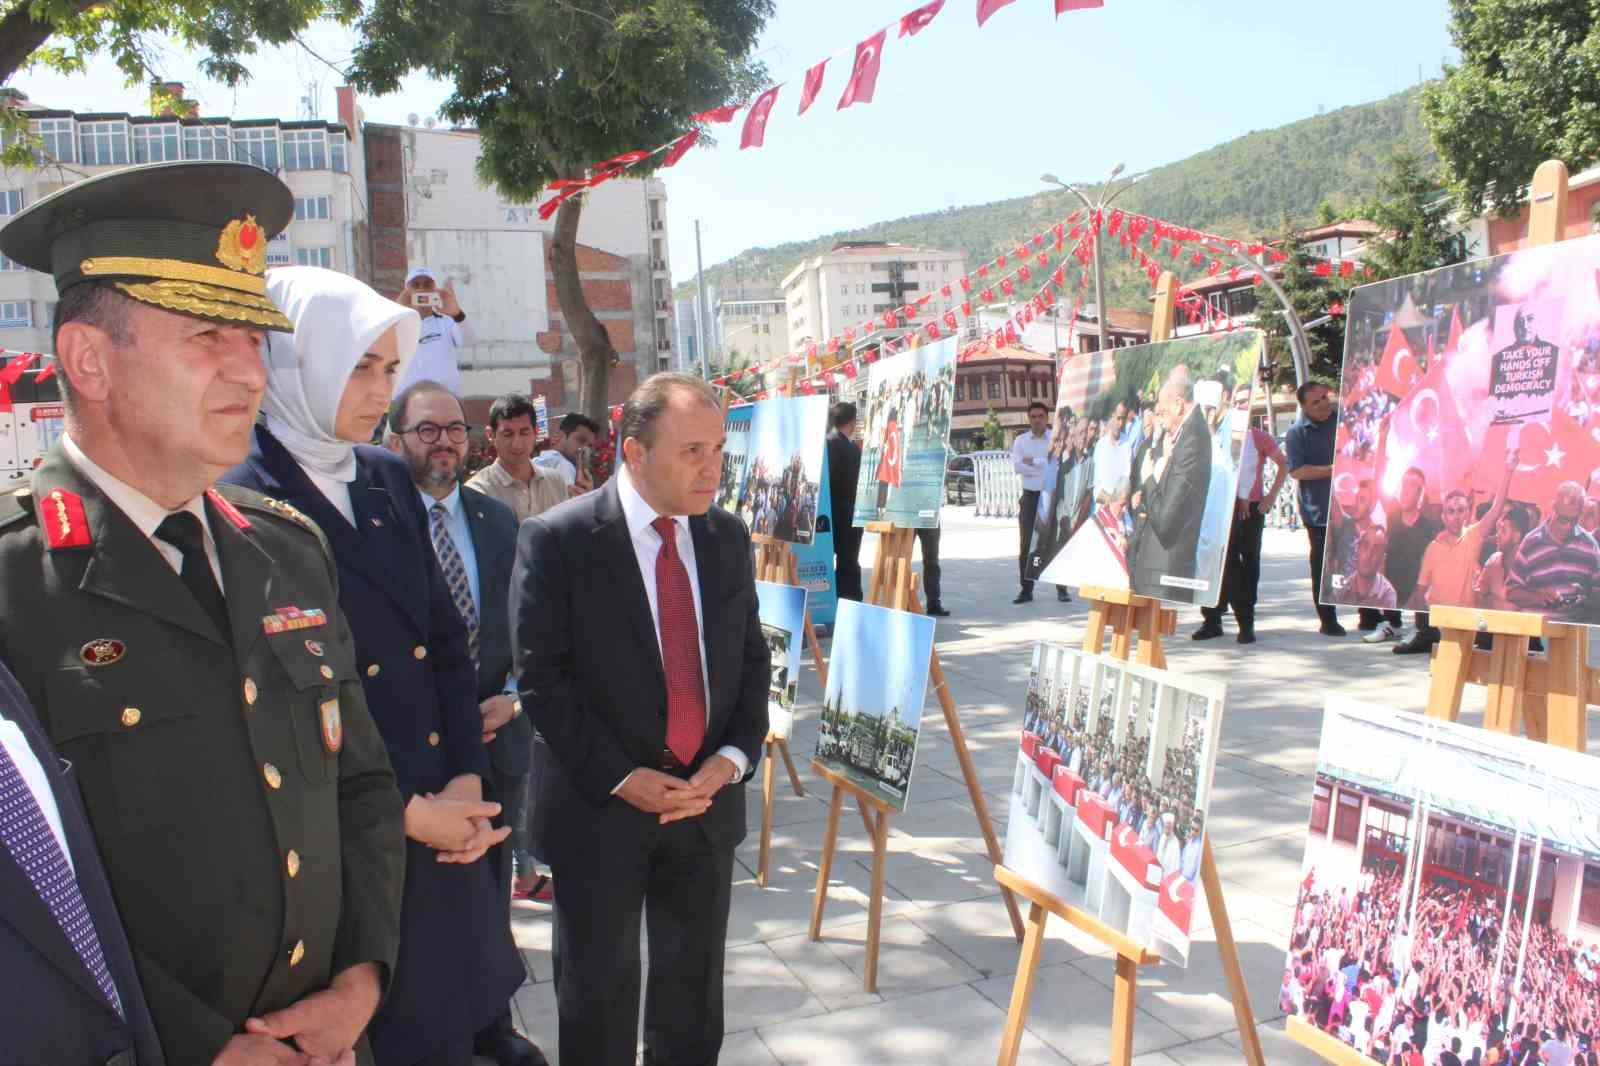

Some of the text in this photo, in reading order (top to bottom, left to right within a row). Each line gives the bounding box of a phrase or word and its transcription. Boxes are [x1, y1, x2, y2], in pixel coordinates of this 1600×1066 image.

[1502, 346, 1552, 359] TAKE YOUR
[1500, 357, 1551, 371] HANDS OFF
[1505, 369, 1544, 382] TURKISH
[1495, 379, 1552, 393] DEMOCRACY
